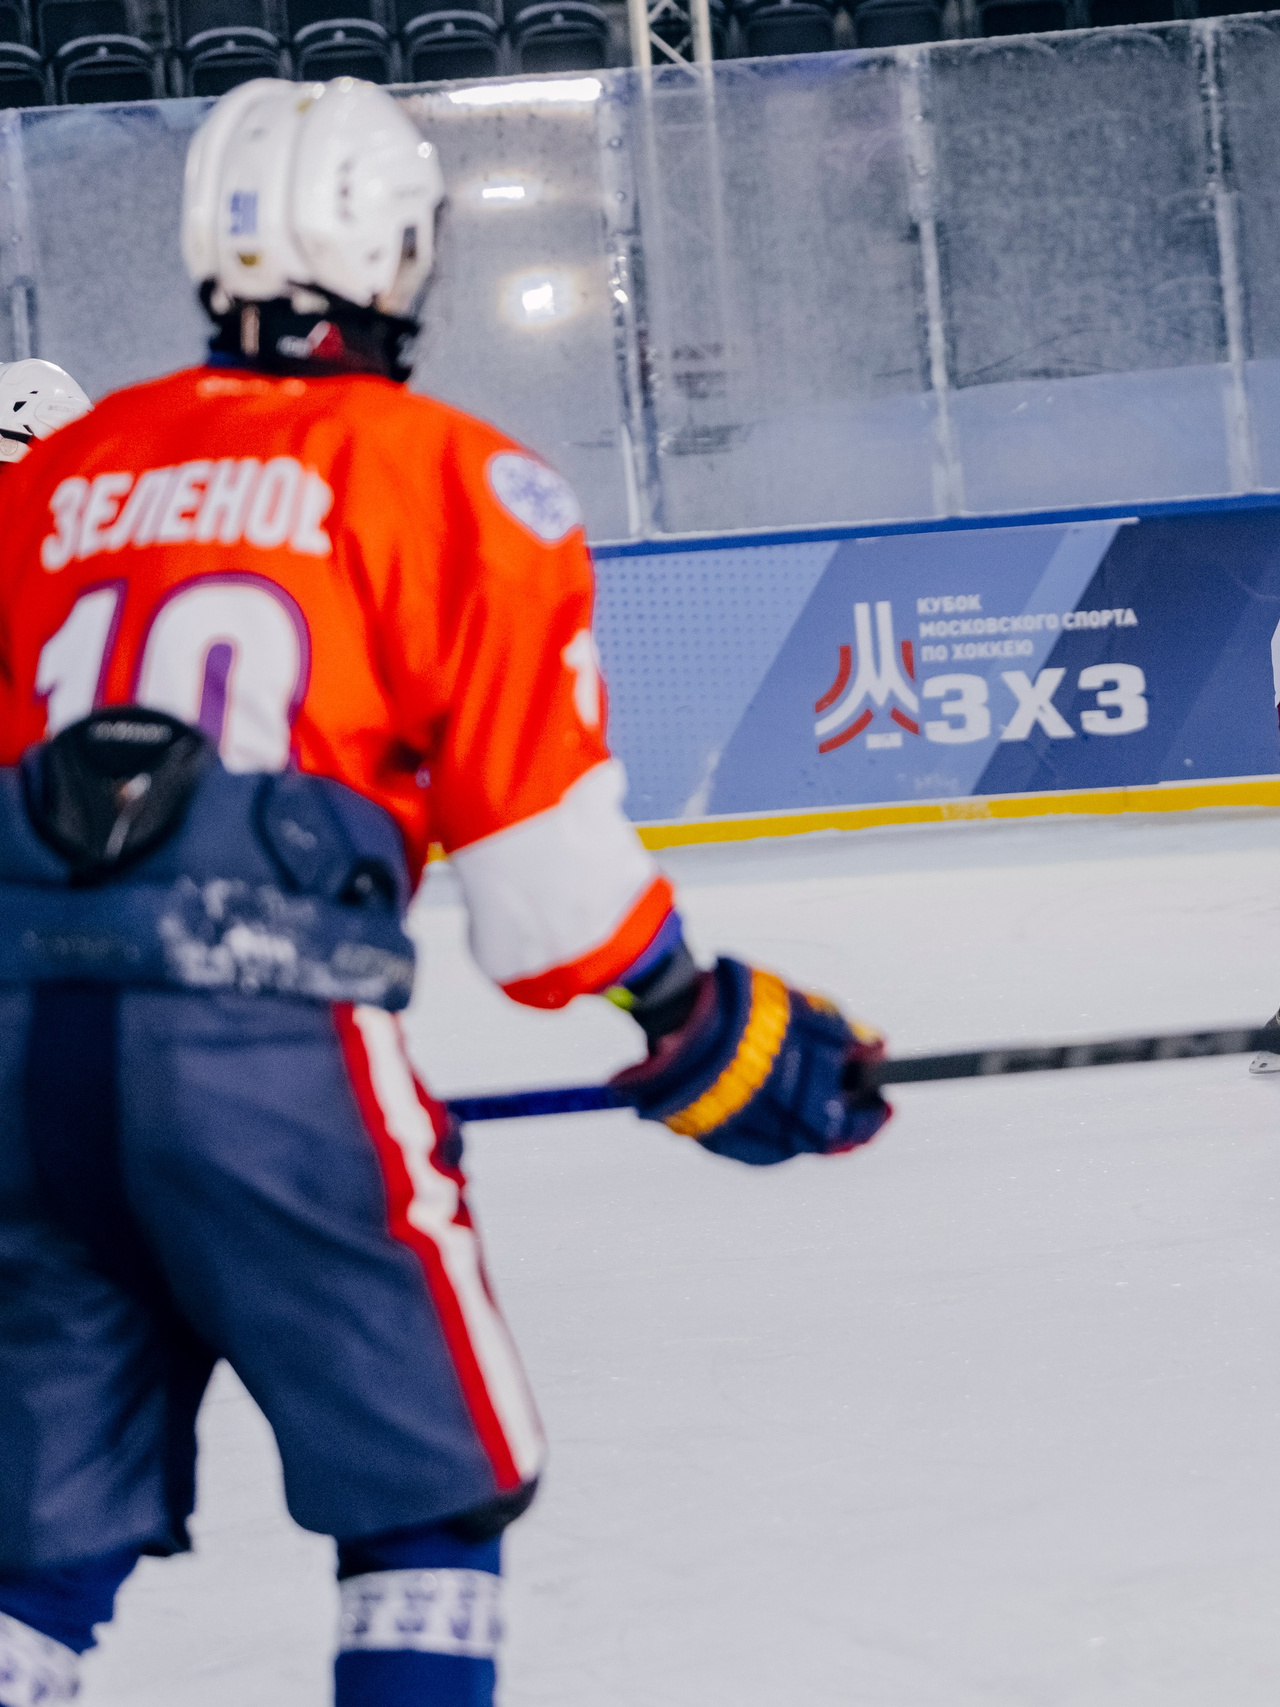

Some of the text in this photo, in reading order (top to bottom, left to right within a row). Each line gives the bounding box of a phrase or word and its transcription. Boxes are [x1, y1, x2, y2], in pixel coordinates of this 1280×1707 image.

[917, 595, 982, 614] КУБОК
[919, 608, 1138, 638] МОСКОВСКОГО СПОРТА
[921, 639, 1034, 661] ПО ХОККЕЮ
[35, 570, 311, 774] 10
